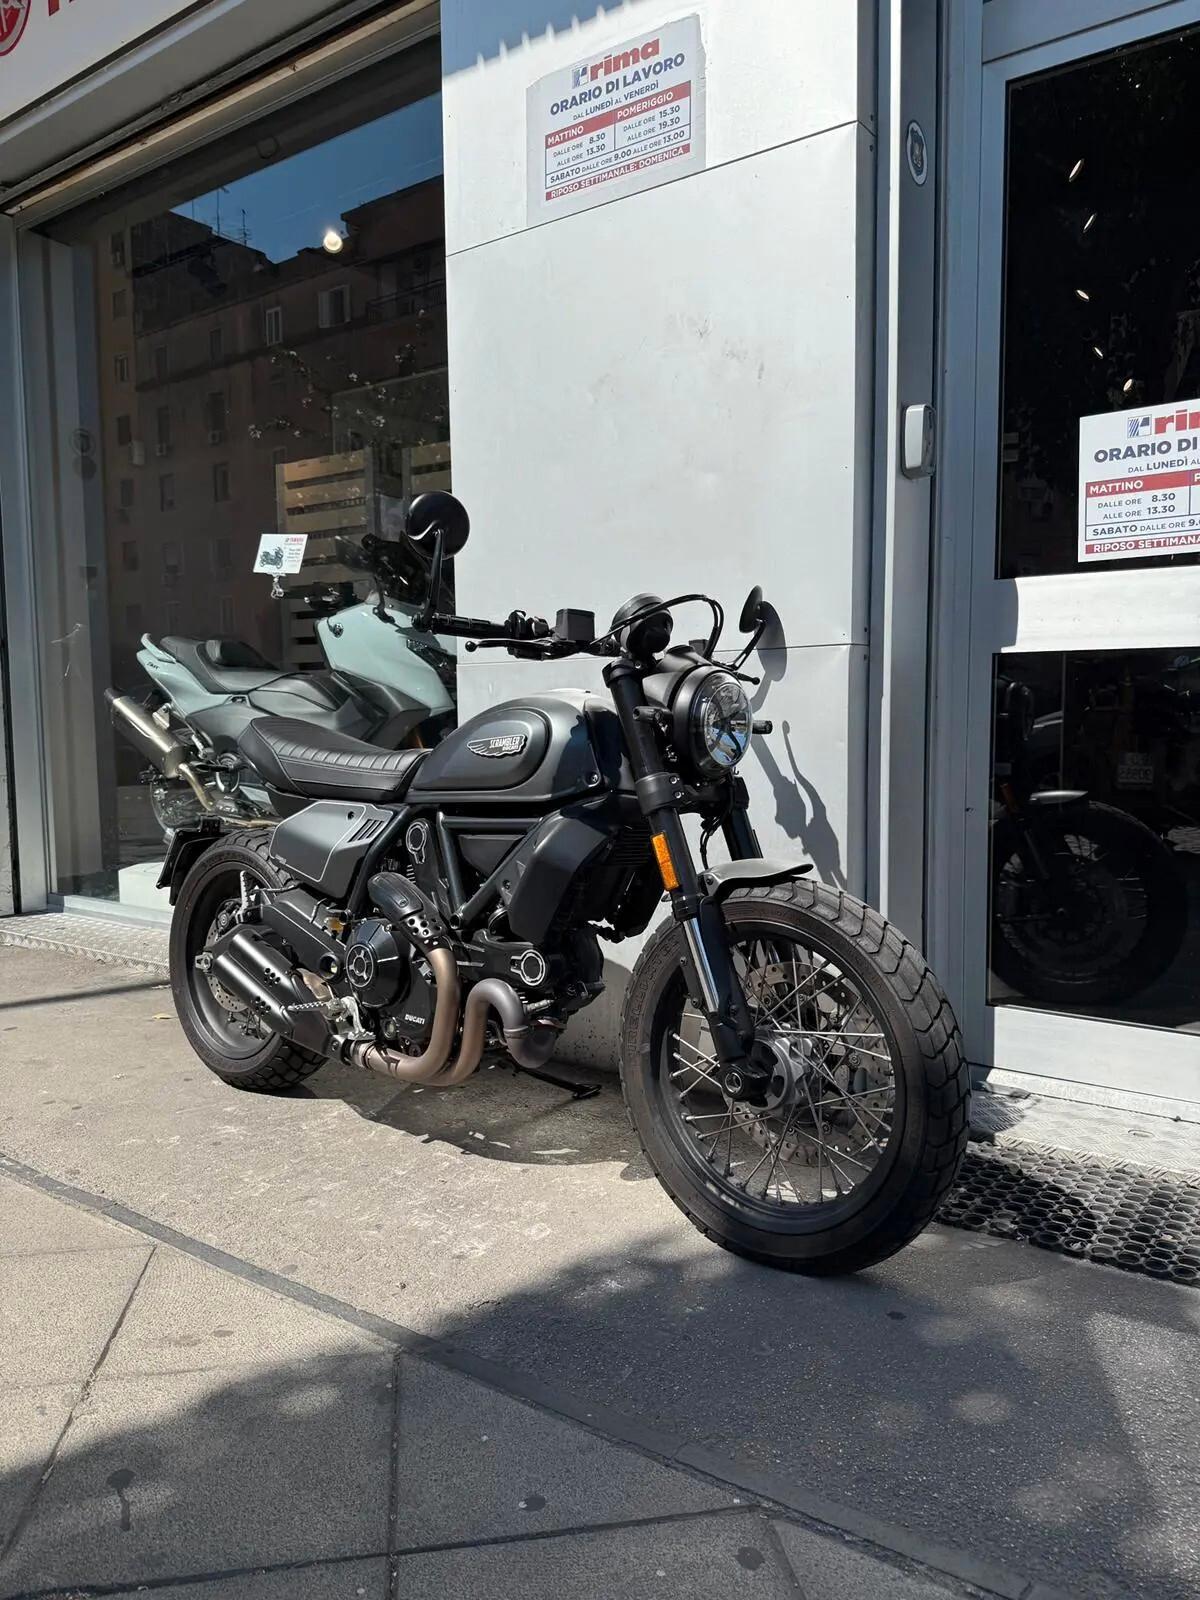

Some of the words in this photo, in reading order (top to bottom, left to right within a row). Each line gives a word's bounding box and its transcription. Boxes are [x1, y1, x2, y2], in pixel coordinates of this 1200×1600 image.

[550, 85, 602, 115] ORARIO
[606, 78, 619, 95] DI
[623, 52, 685, 87] LAVORO
[573, 112, 584, 121] DAL
[585, 98, 614, 118] LUNEDÌ
[624, 80, 659, 101] VENERDÌ
[617, 91, 674, 119] POMERIGGIO
[623, 119, 642, 131] DALLE
[643, 115, 656, 126] ORE
[659, 105, 680, 118] 15.30
[627, 131, 641, 141] ALLE
[643, 127, 656, 137] ORE
[659, 117, 680, 130] 19.30
[548, 125, 584, 146] MATTINO
[554, 146, 570, 157] DALLE
[572, 142, 583, 152] ORE
[589, 132, 606, 144] 8.30
[550, 167, 581, 183] SABATO
[582, 162, 600, 173] DALLE
[601, 158, 613, 168] ORE
[614, 149, 632, 161] 9.00
[633, 145, 648, 154] ALLE
[649, 140, 662, 150] ORE
[663, 131, 685, 144] 13.00
[557, 157, 571, 166] ALLE
[572, 153, 583, 163] ORE
[586, 144, 606, 156] 13.30
[551, 182, 579, 198] RIPOSO
[581, 163, 638, 188] SETTIMANALE:
[639, 147, 683, 168] DOMENICA
[1094, 443, 1171, 462] ORARIO
[1178, 439, 1197, 452] DI
[1146, 456, 1188, 471] LUNEDÌ
[1090, 480, 1143, 494] MATTINO
[1098, 499, 1122, 508] DALLE
[1152, 493, 1175, 502] 8.30
[1147, 505, 1175, 515] 13.30
[1093, 525, 1137, 536] SABATO
[1140, 523, 1167, 532] DALLE
[1094, 541, 1135, 552] RIPOSO
[490, 736, 520, 748] SCRAMBLER
[404, 1014, 425, 1024] DUCATI
